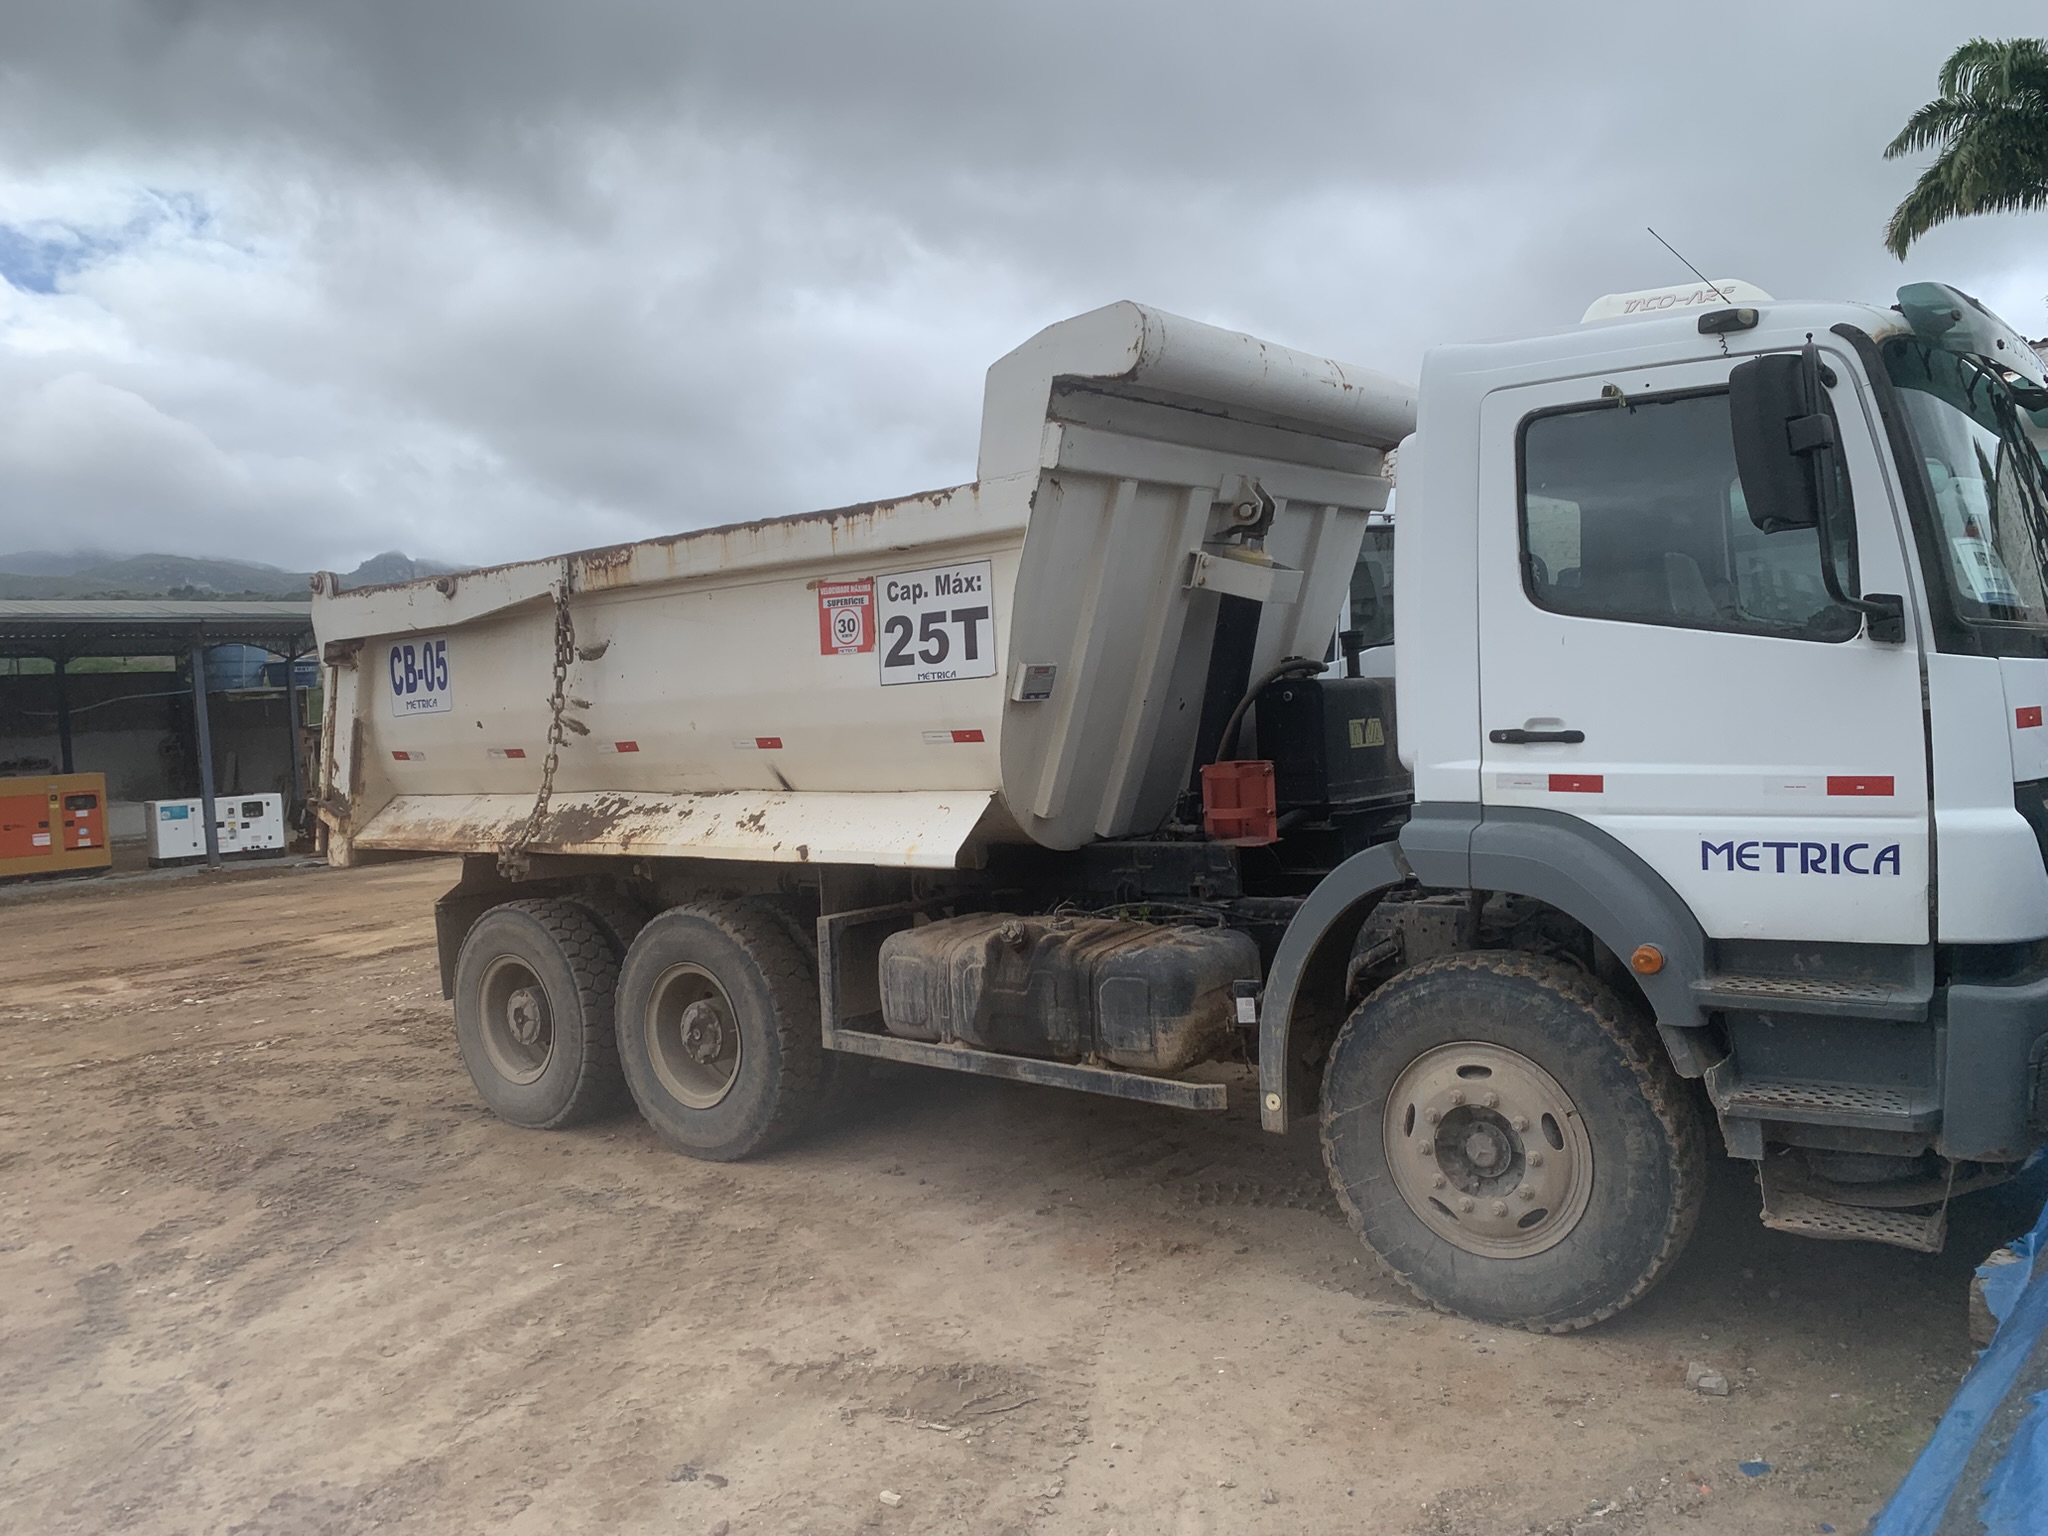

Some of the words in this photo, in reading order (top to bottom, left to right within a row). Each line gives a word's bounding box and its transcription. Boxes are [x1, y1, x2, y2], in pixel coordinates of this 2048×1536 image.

[887, 581, 929, 604] Cap.
[935, 572, 982, 597] Máx:
[838, 618, 856, 633] 30
[884, 606, 989, 668] 25T
[390, 640, 448, 696] CB-05
[1701, 840, 1900, 876] METRICA
